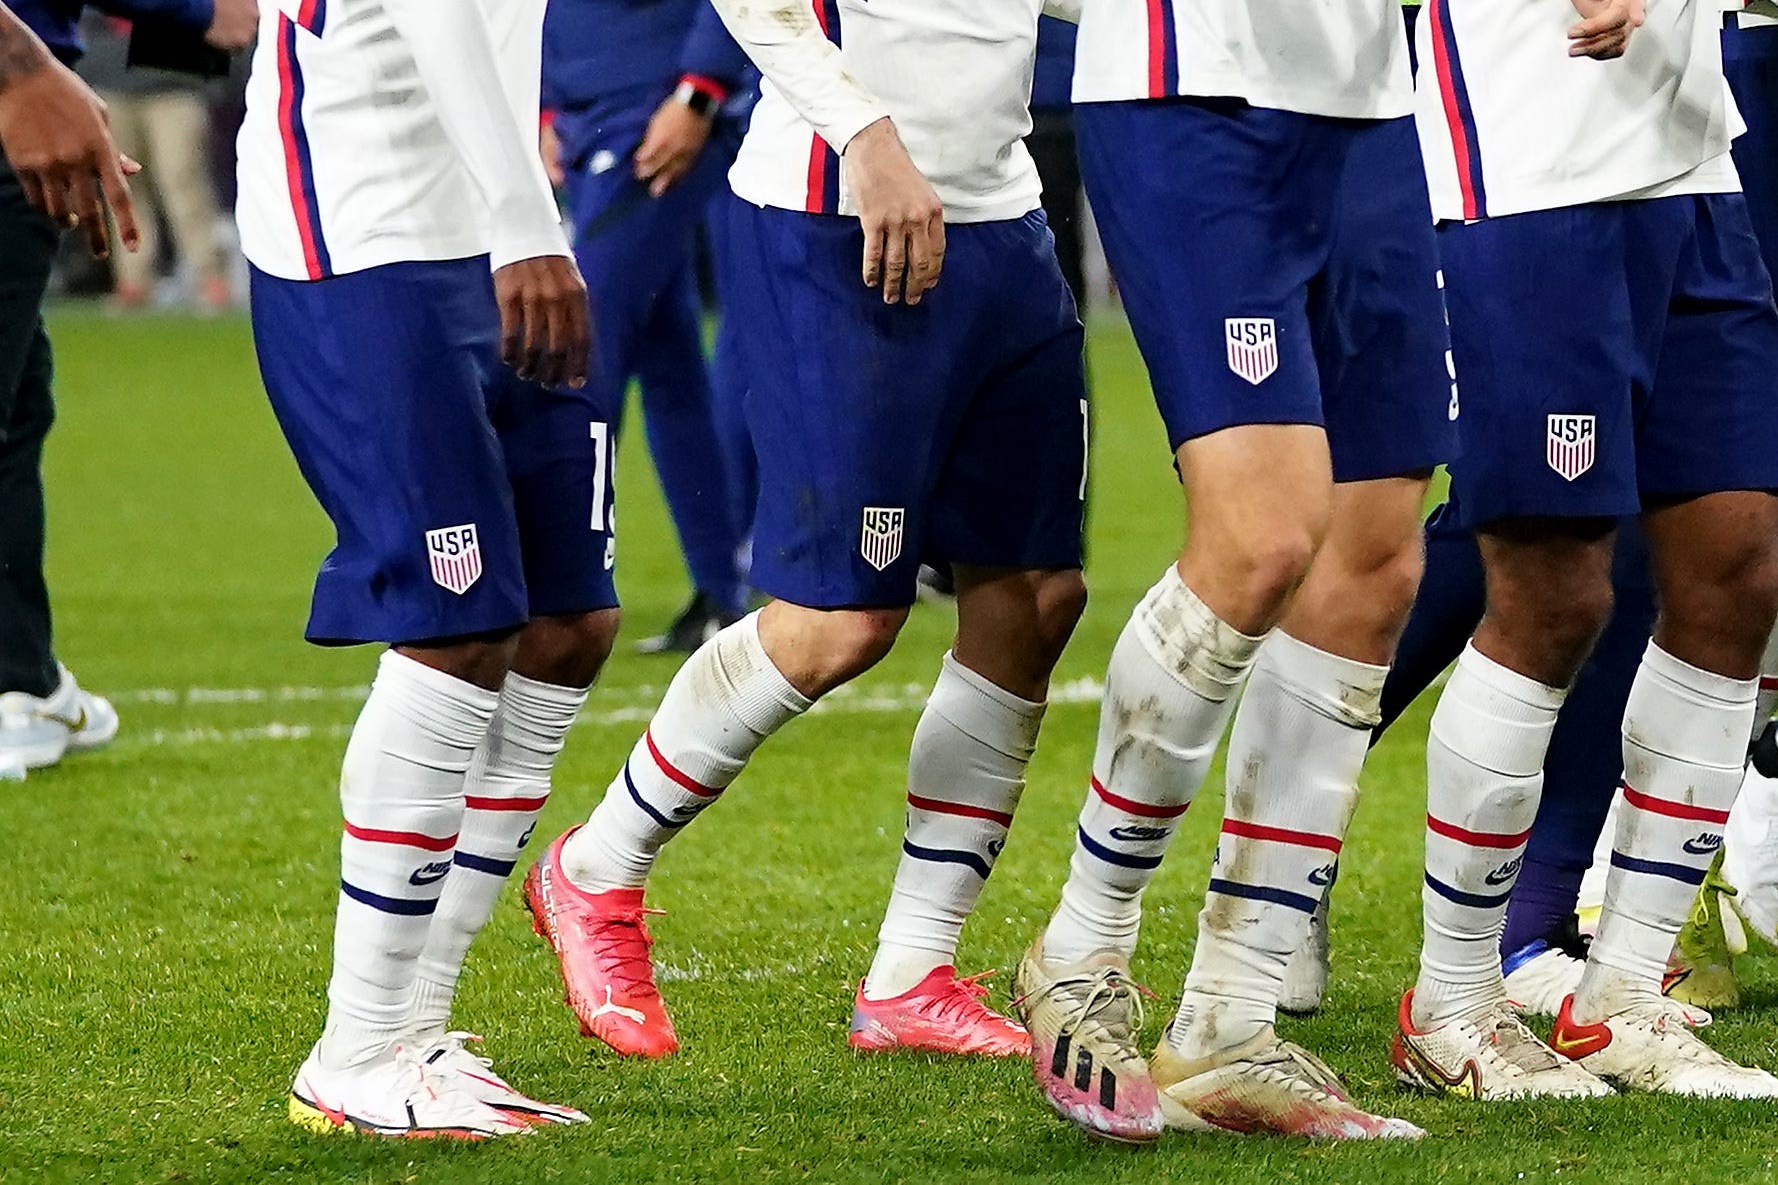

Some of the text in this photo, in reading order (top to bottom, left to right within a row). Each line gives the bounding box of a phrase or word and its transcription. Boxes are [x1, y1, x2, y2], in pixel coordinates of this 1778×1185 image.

[1230, 322, 1272, 346] USA
[1550, 418, 1593, 443] USA
[866, 510, 902, 535] USA
[430, 528, 475, 556] USA
